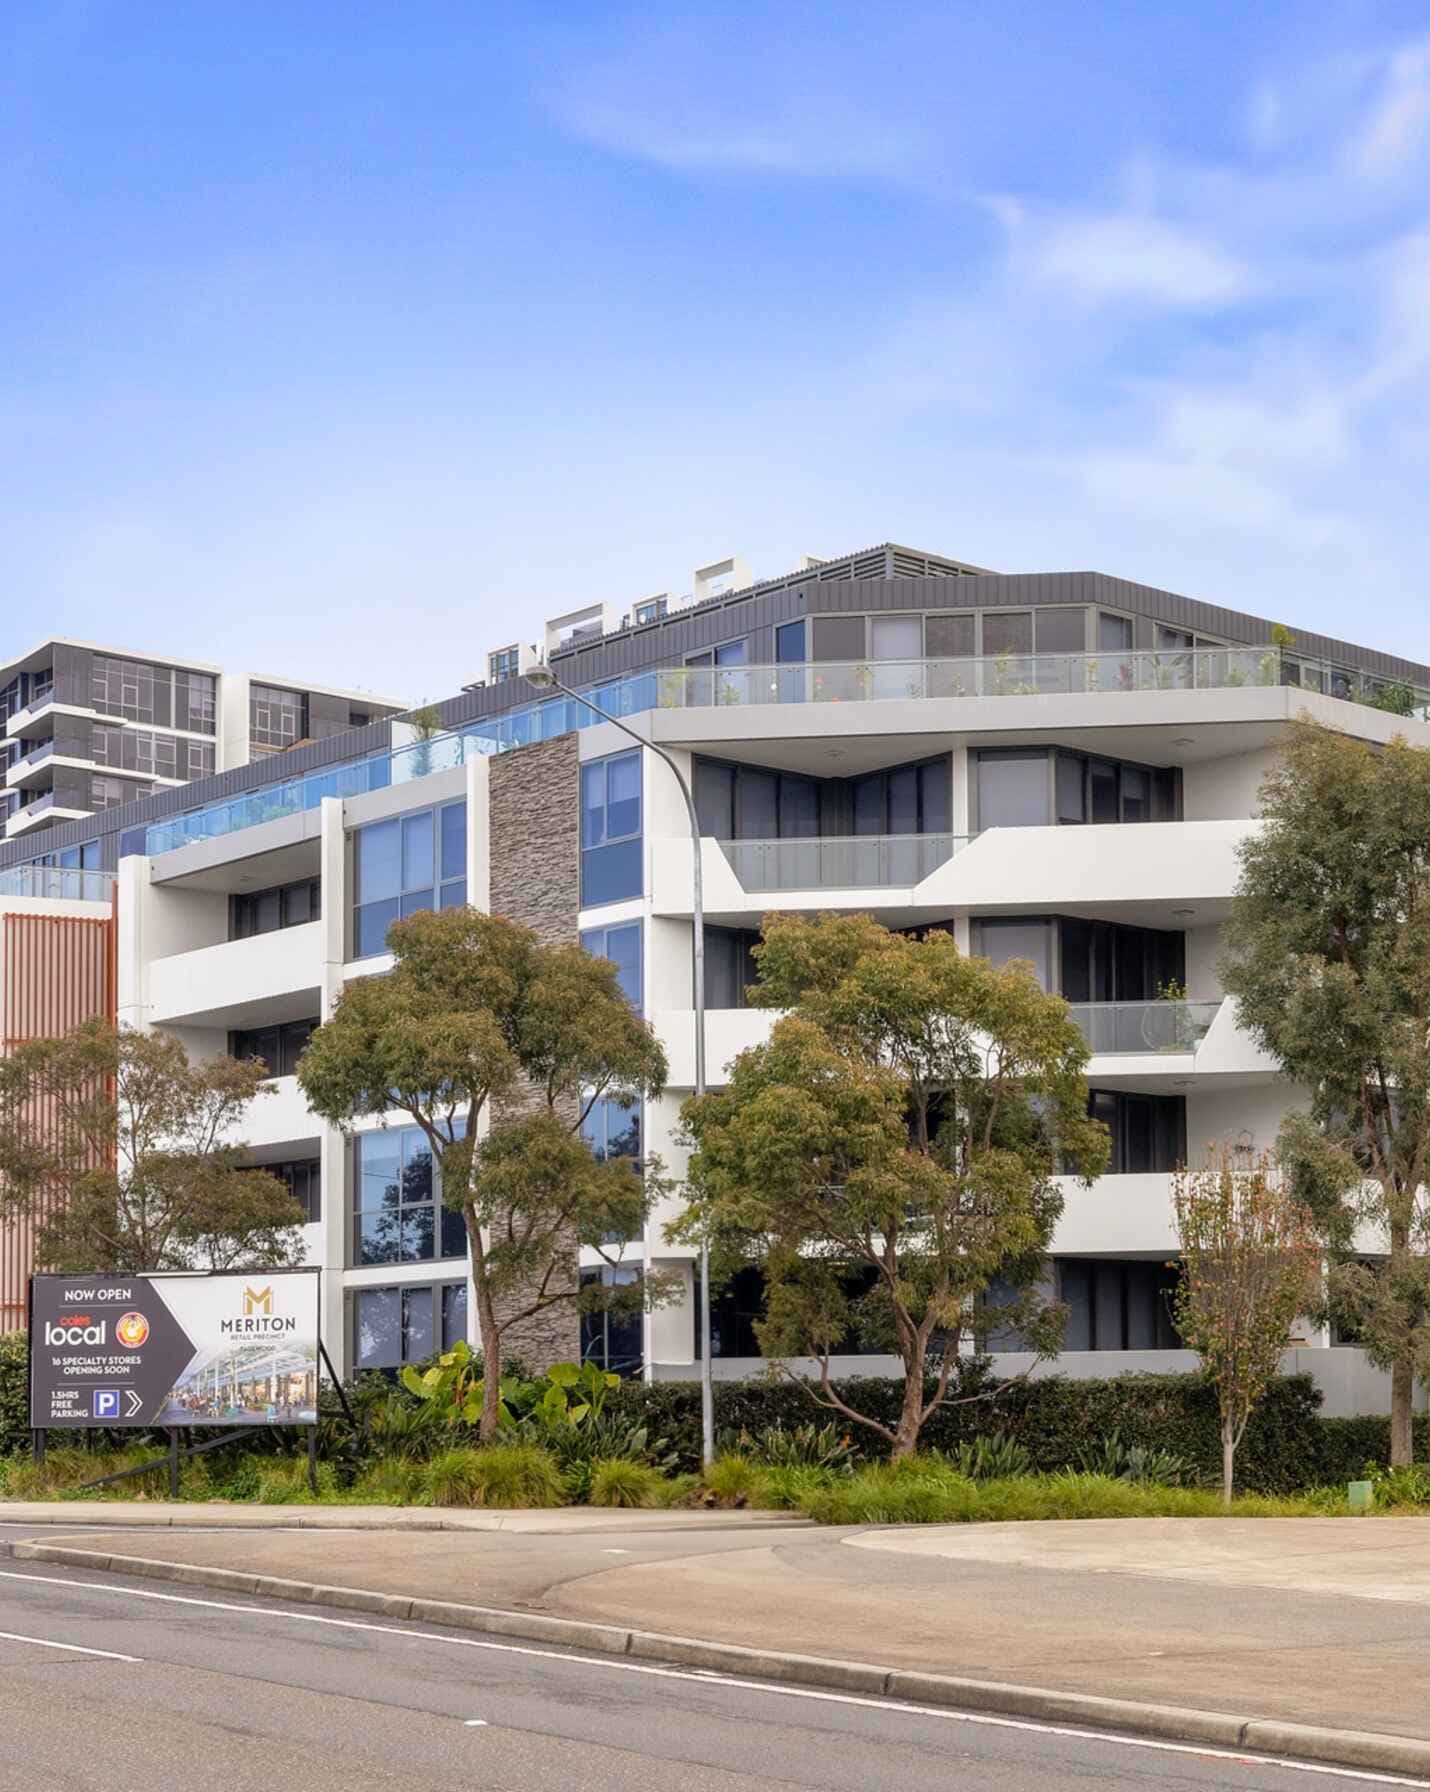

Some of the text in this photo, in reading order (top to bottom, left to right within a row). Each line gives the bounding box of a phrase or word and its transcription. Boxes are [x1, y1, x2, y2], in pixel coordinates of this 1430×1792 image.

[65, 1289, 131, 1301] NOW OPEN
[221, 1317, 296, 1332] MERITON
[45, 1320, 106, 1345] local
[52, 1355, 141, 1366] 16 SPECIALTY STORES
[63, 1366, 130, 1375] OPENING SOON
[51, 1400, 72, 1408] FREE
[99, 1393, 115, 1415] P
[51, 1409, 88, 1418] PARKING
